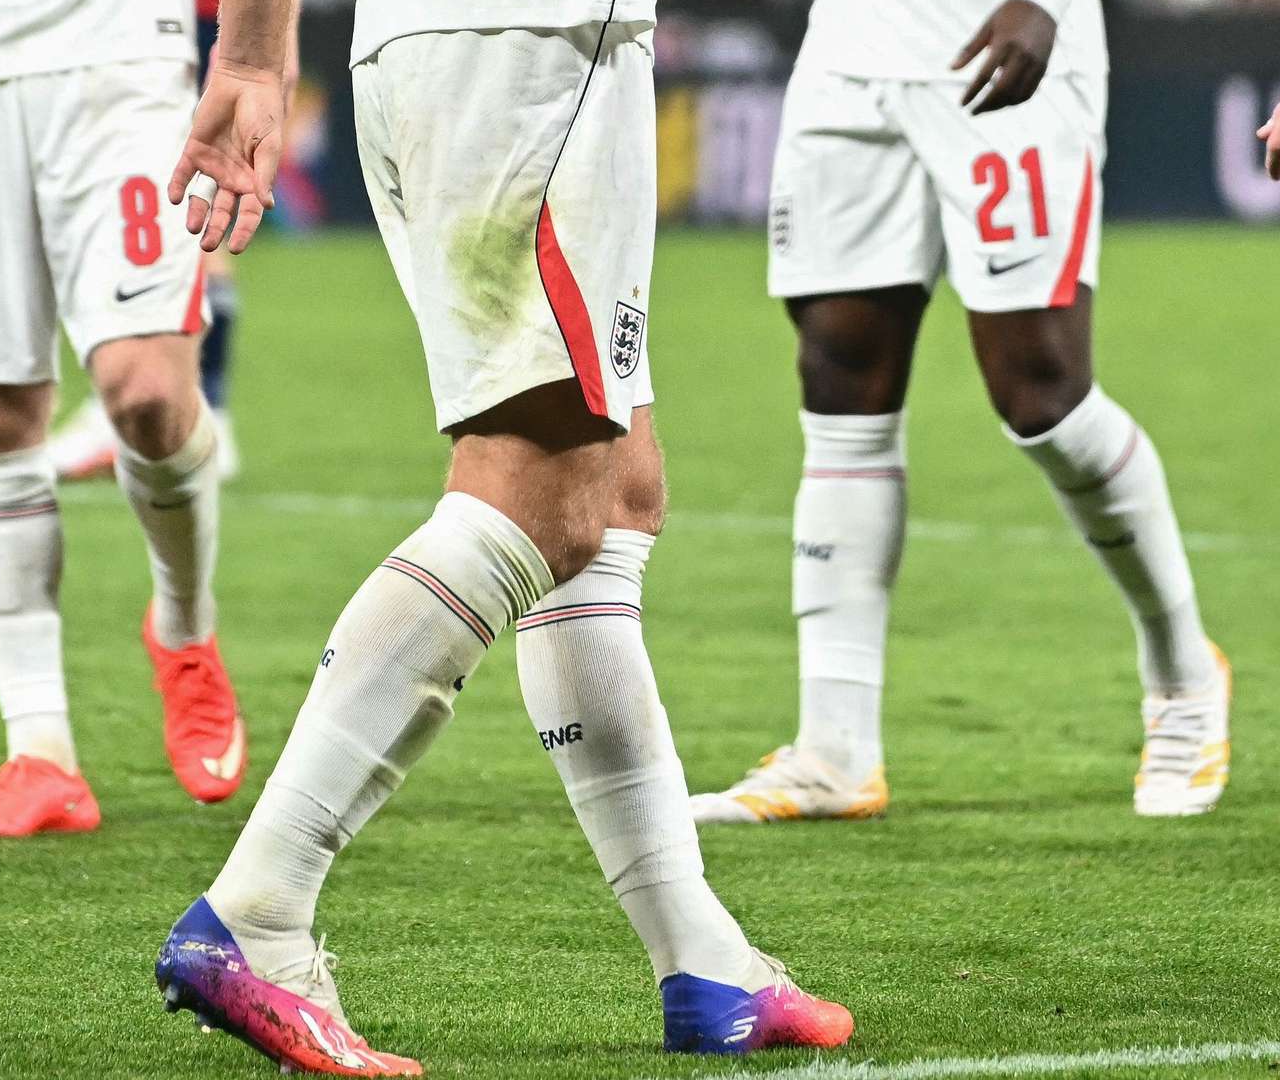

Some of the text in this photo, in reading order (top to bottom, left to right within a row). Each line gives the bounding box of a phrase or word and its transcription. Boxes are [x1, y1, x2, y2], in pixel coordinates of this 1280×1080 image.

[119, 174, 162, 266] 8
[971, 146, 1051, 243] 21
[539, 723, 583, 751] ENG
